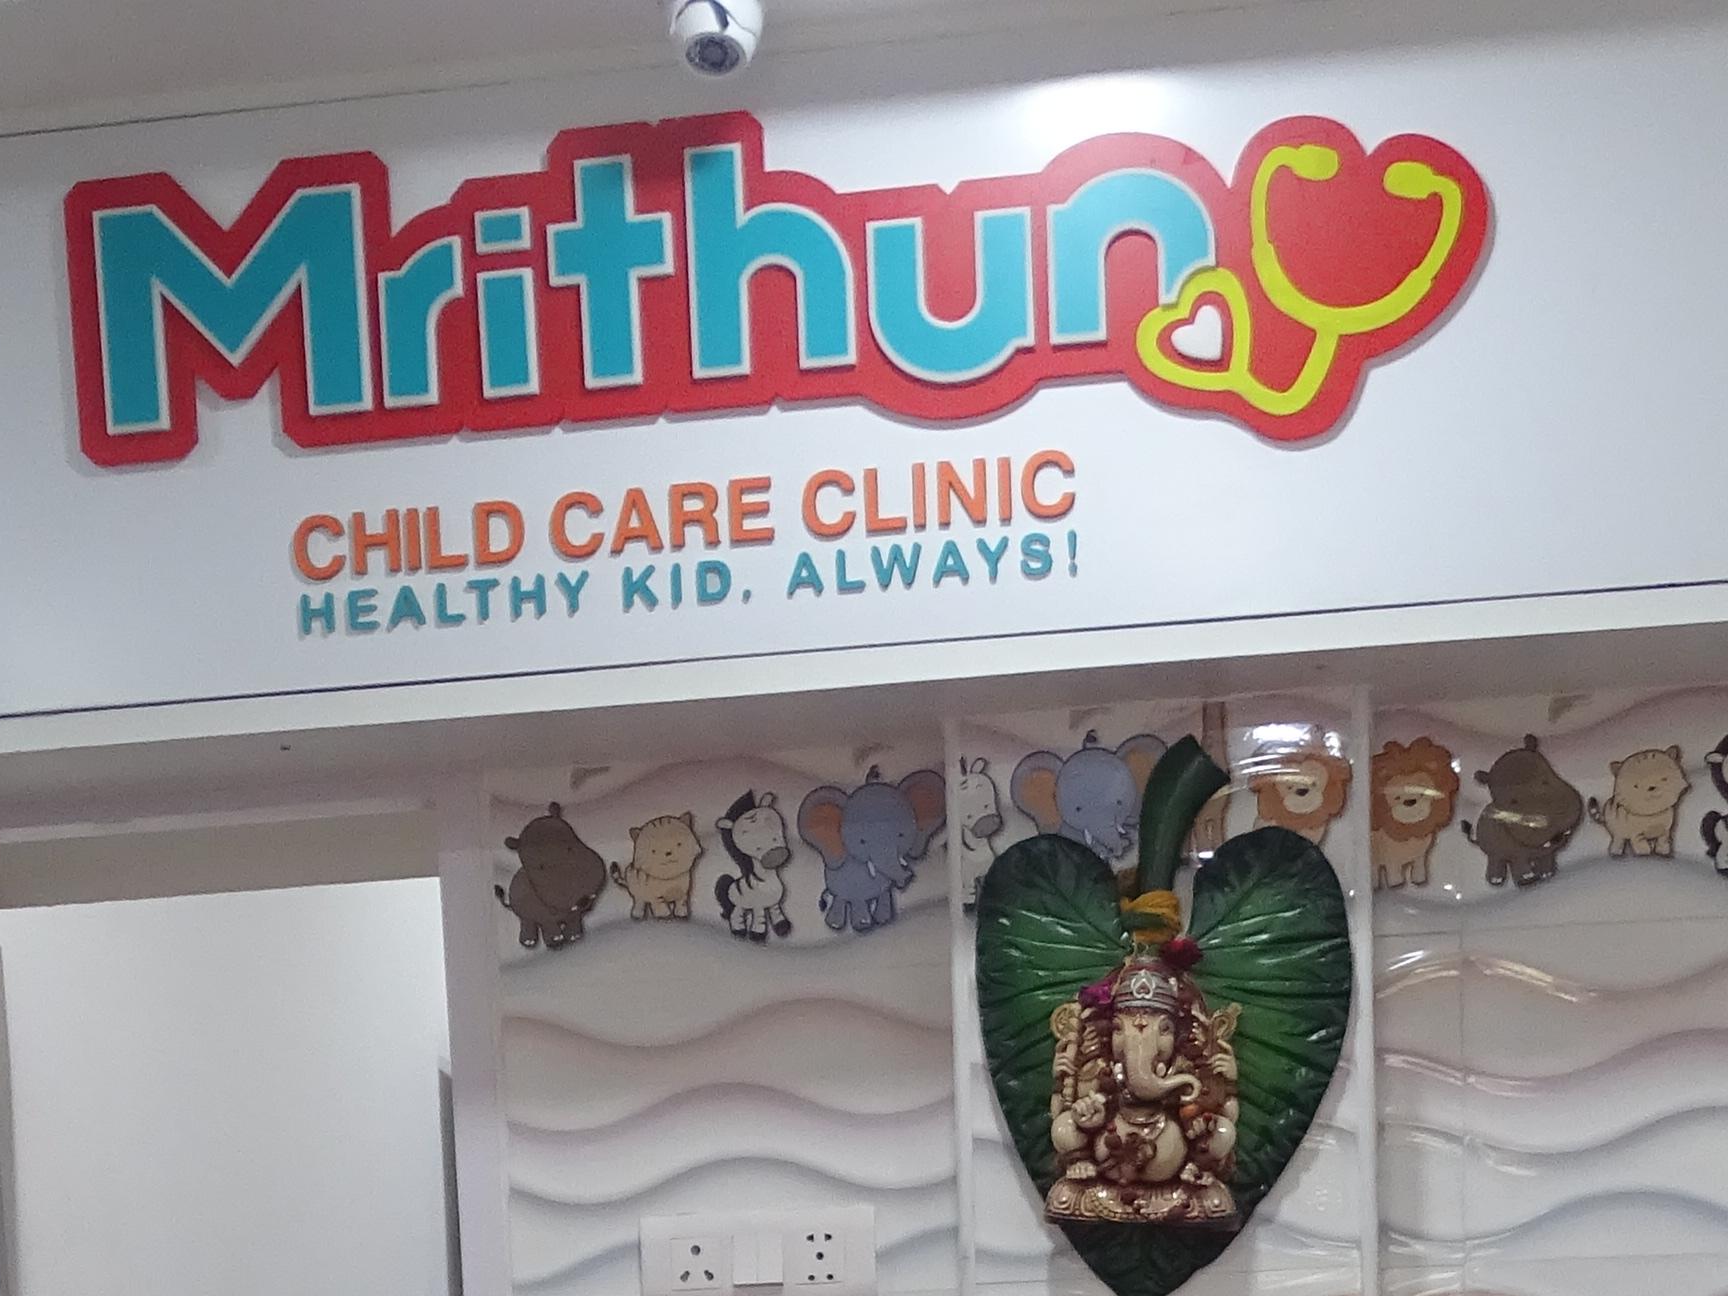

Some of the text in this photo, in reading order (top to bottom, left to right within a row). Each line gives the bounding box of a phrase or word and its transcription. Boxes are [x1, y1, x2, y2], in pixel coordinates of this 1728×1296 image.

[92, 143, 1218, 434] Mrithun
[293, 449, 1078, 582] CHILD CARE CLINIC
[299, 530, 1079, 637] HEALTHY KID. ALWAYS!
